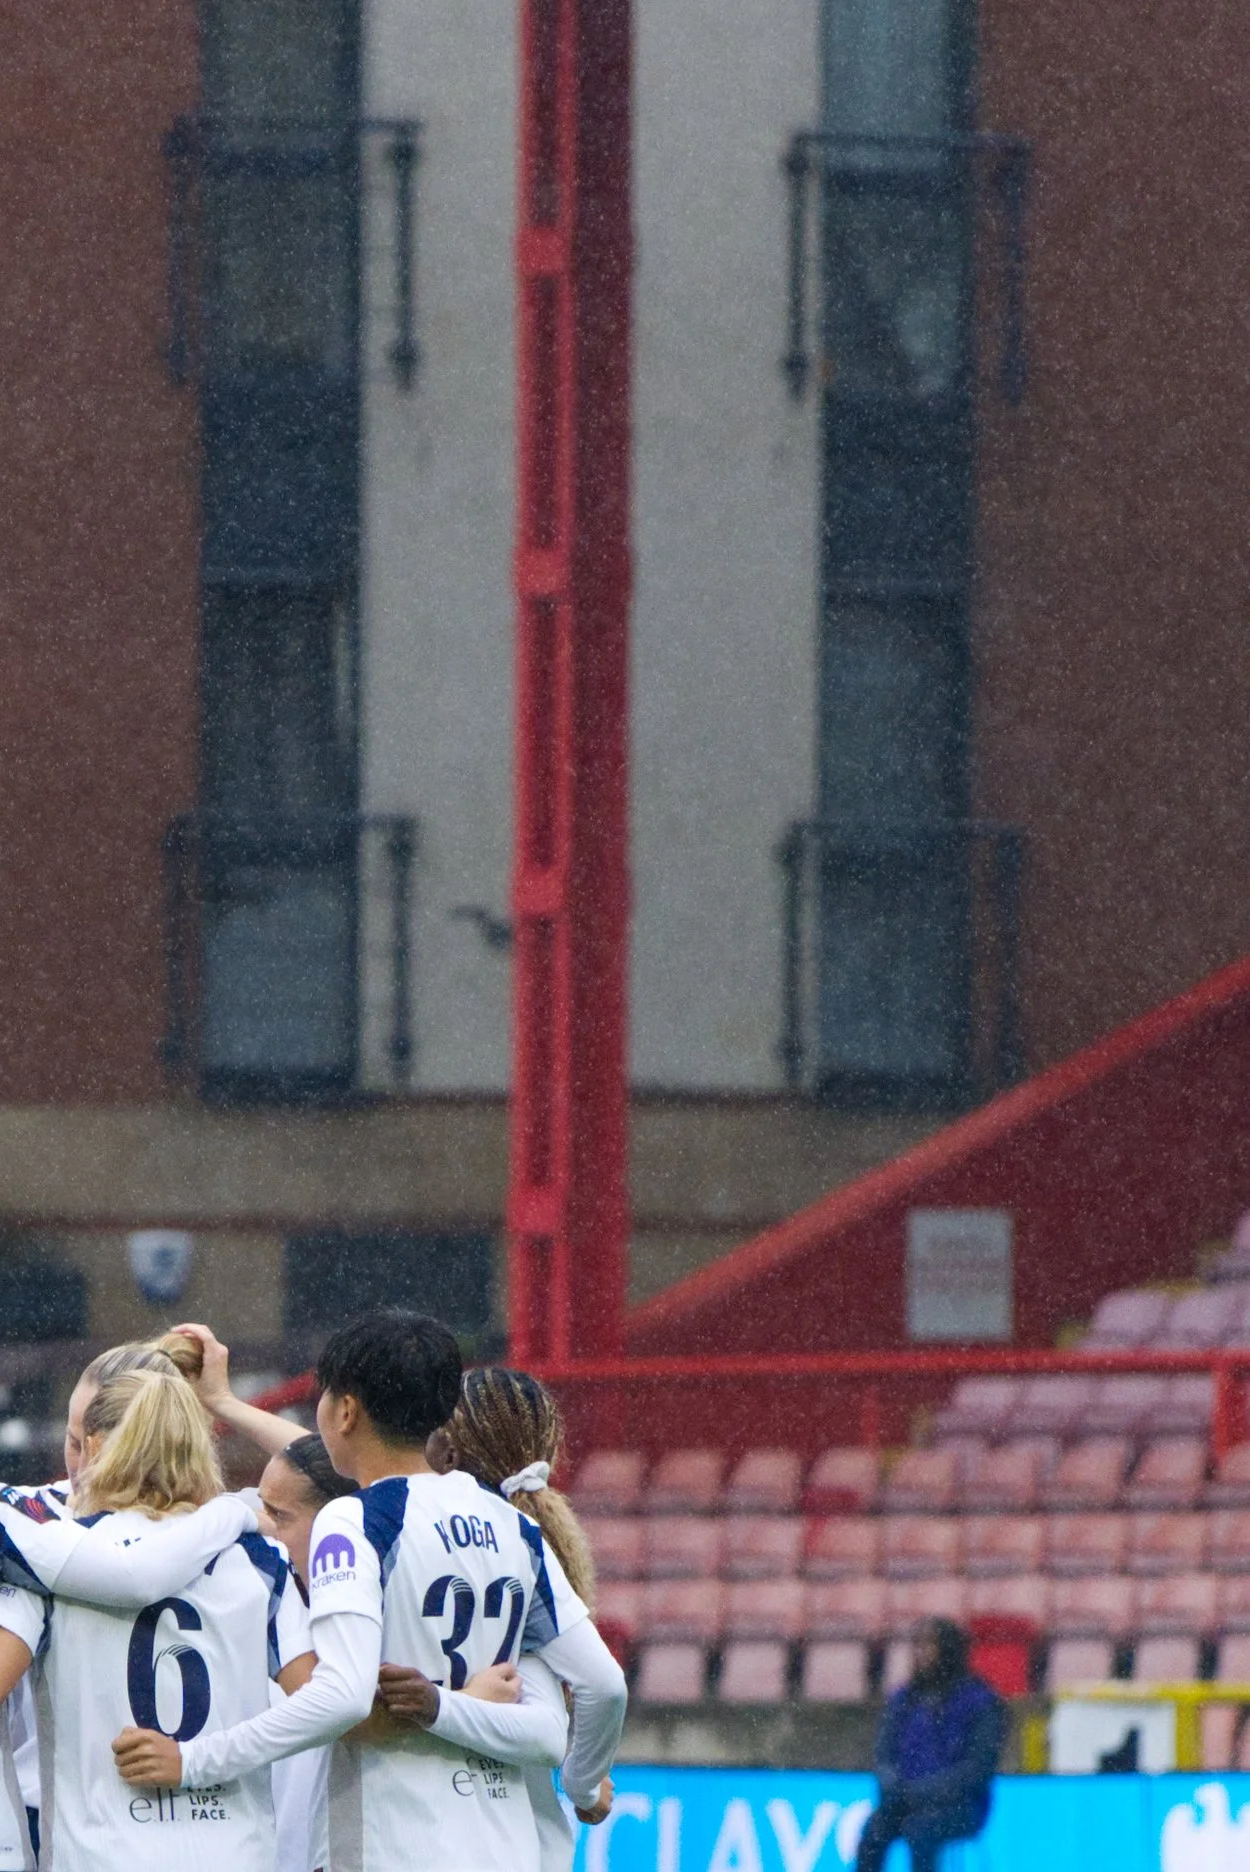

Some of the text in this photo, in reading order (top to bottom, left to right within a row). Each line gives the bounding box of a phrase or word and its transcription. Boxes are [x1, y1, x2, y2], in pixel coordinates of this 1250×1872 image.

[434, 1514, 499, 1554] KOGA
[312, 1570, 357, 1592] kraken
[127, 1597, 211, 1742] 6
[191, 1809, 231, 1820] FACE.
